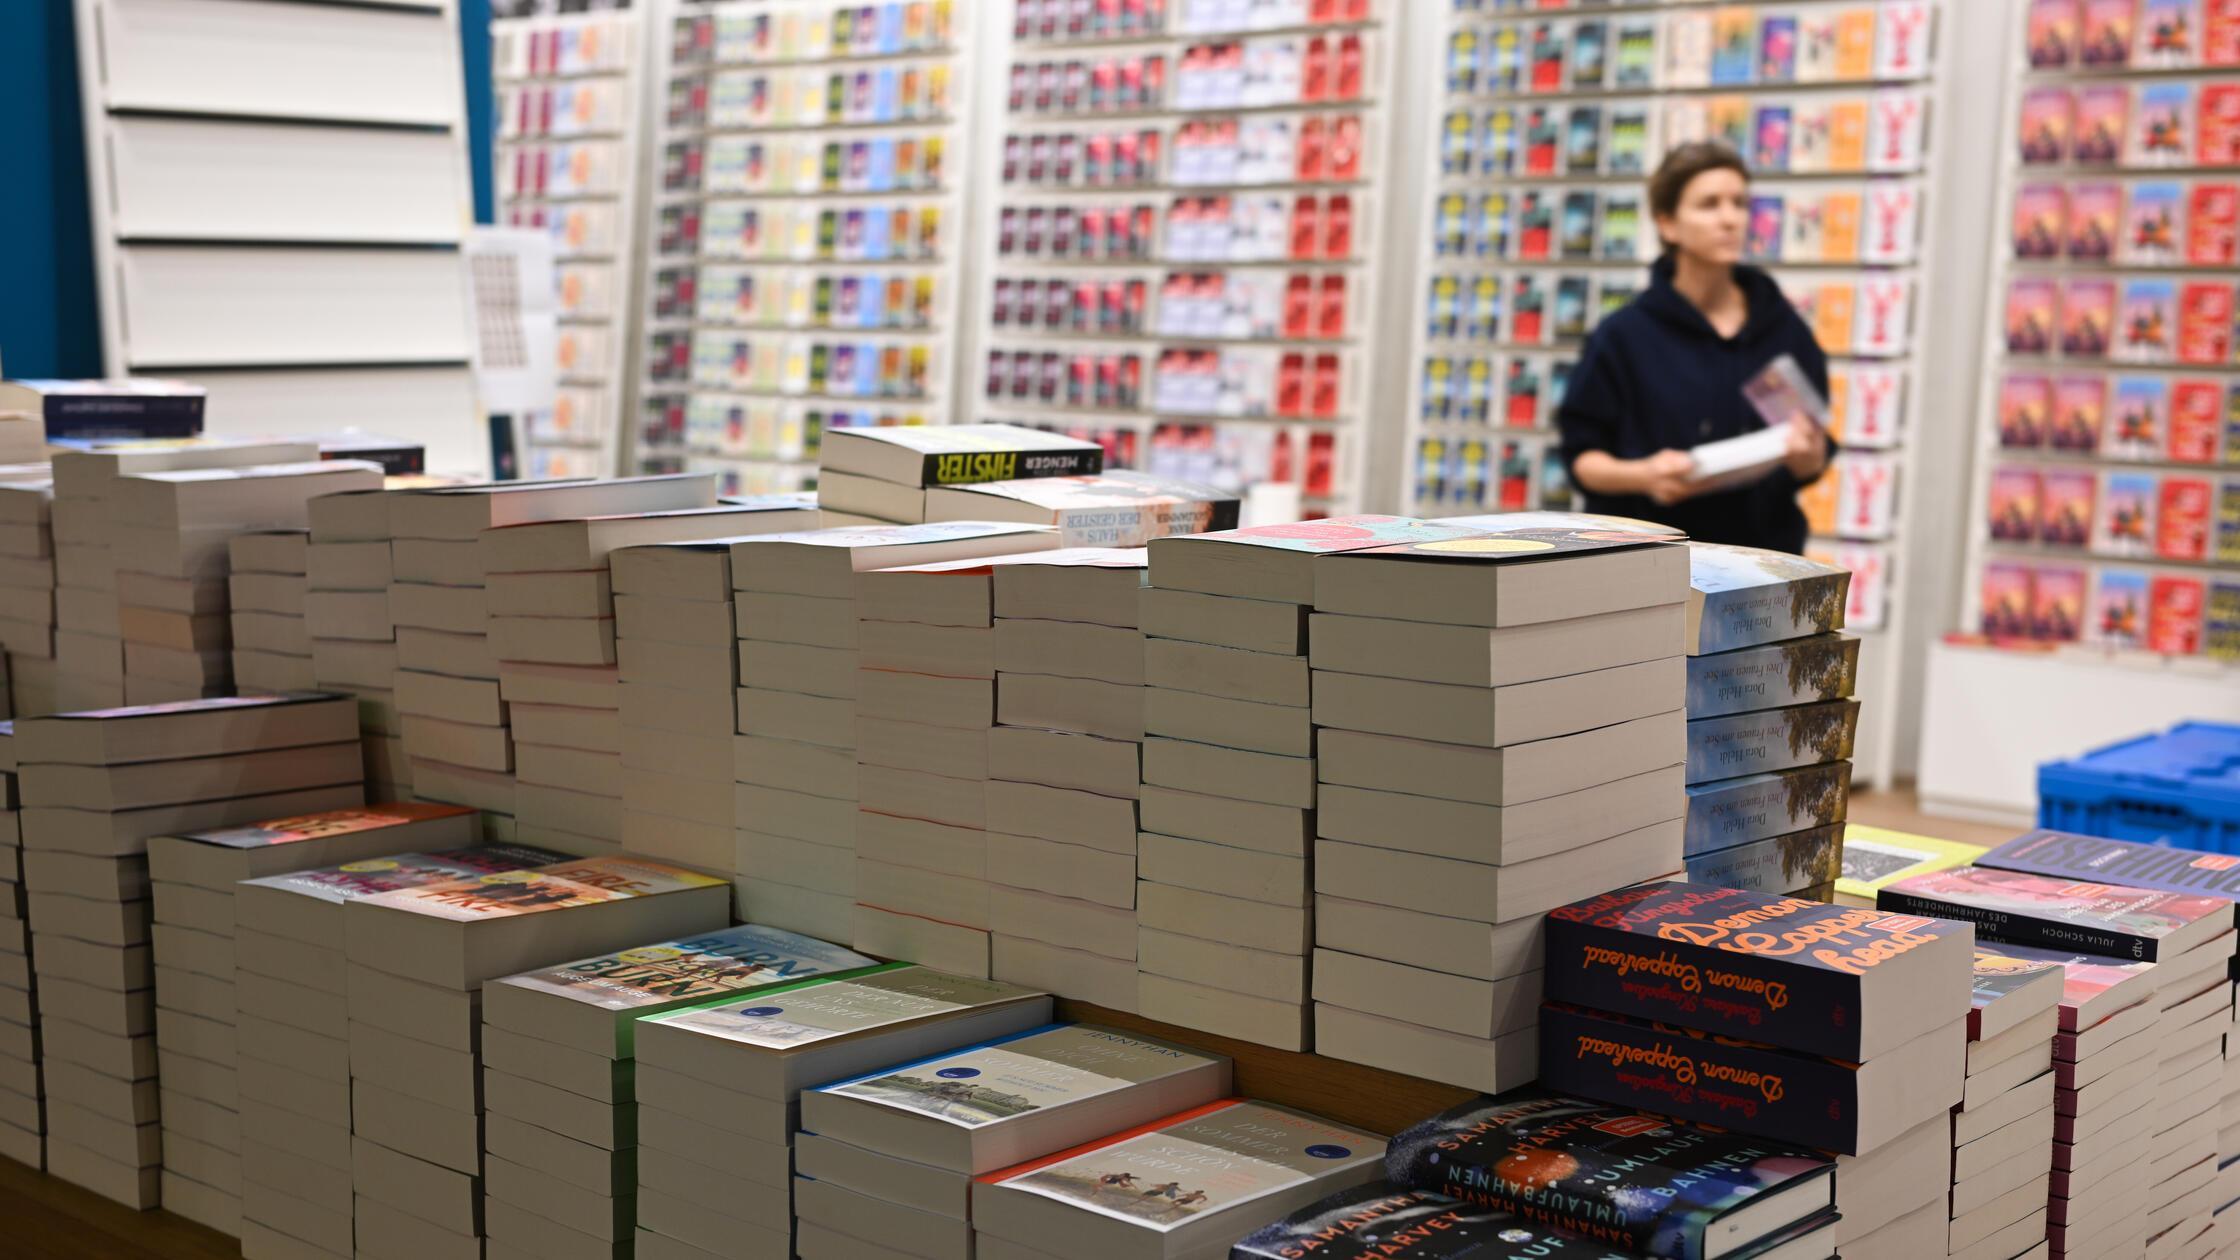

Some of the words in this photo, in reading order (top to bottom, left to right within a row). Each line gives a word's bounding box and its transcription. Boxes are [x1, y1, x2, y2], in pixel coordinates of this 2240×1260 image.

[937, 453, 1016, 484] FINSTER
[1025, 456, 1079, 469] MENGER
[1067, 514, 1117, 528] GEISTER
[1119, 512, 1141, 524] DER
[1087, 530, 1119, 543] HAUS
[1735, 601, 1744, 611] am
[1745, 597, 1772, 610] Frauen
[1775, 595, 1788, 606] Drei
[1721, 603, 1735, 614] See
[1732, 620, 1754, 634] Heldt
[1753, 616, 1772, 628] Dora
[1704, 671, 1723, 681] See
[1724, 668, 1736, 678] am
[1736, 665, 1764, 677] Frauen
[1766, 663, 1783, 675] Drei
[1718, 686, 1742, 701] Heldt
[1745, 683, 1765, 694] Dora
[1704, 734, 1722, 744] See
[1722, 732, 1736, 741] am
[1737, 728, 1764, 741] Frauen
[1766, 726, 1784, 738] Drei
[1719, 749, 1744, 766] Heldt
[1746, 746, 1766, 758] Dora
[1726, 799, 1738, 810] am
[1739, 795, 1765, 809] Frauen
[1766, 792, 1784, 804] Drei
[1710, 802, 1725, 814] See
[1722, 817, 1744, 832] Heldt
[1746, 813, 1766, 825] Dora
[1906, 900, 1987, 922] JAHRHUNDERTS
[1988, 913, 2008, 923] DES
[1658, 899, 1824, 947] Demon
[1978, 921, 1997, 932] DAS
[1718, 909, 1896, 956] Copper
[2042, 927, 2084, 943] SCHOCH
[2088, 934, 2116, 948] JULIA
[2132, 938, 2144, 958] dtv
[674, 938, 819, 977] BURN
[1812, 932, 1939, 976] head
[1583, 946, 1702, 993] Copperhead
[568, 959, 716, 997] BURN
[613, 986, 652, 999] AUGE
[1706, 970, 1788, 1011] Demon
[1082, 1031, 1144, 1048] JENNY
[1144, 1045, 1185, 1059] HAN
[1577, 1035, 1697, 1085] Copperhead
[1701, 1061, 1784, 1103] Demon
[1232, 1122, 1287, 1139] DER
[1437, 1097, 1572, 1151] SAMANTHA
[1507, 1112, 1607, 1154] HARVEY
[1594, 1133, 1705, 1182] UMLAUF
[1650, 1145, 1768, 1198] BAHNEN
[1441, 1183, 1517, 1216] HARVEY
[1448, 1165, 1627, 1227] UMLAUFBAHNEN
[1280, 1190, 1426, 1259] SAMANTHA
[1523, 1204, 1634, 1249] SAMANTHA
[1353, 1210, 1465, 1260] HARVEY
